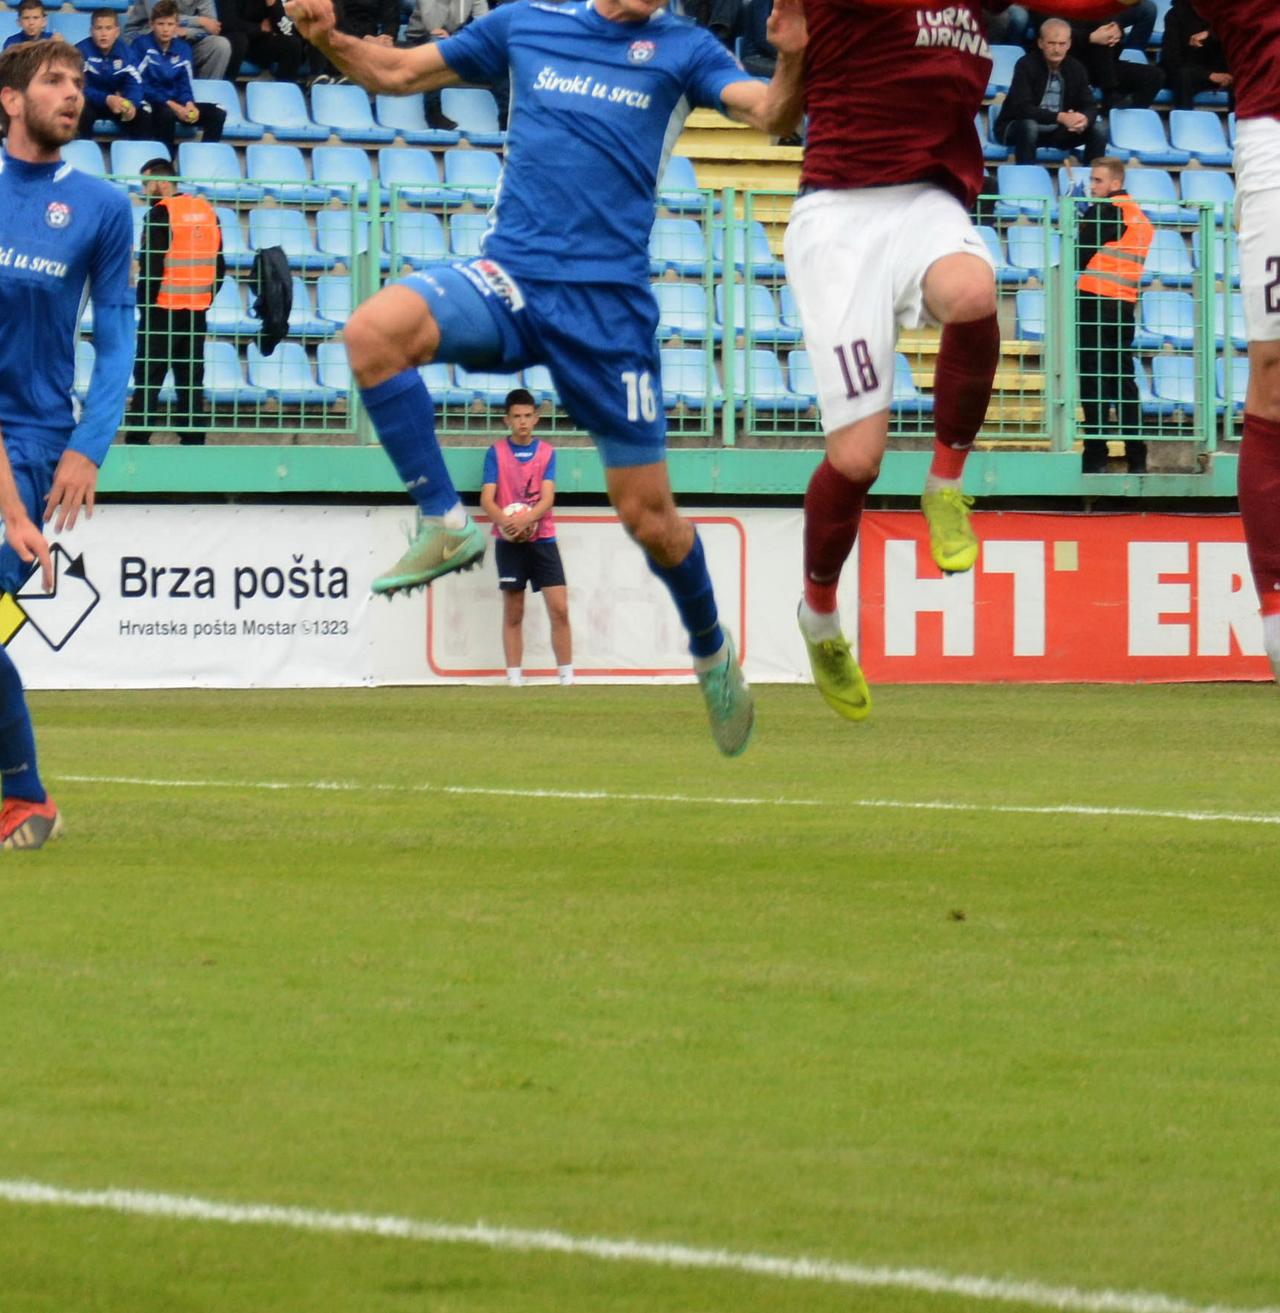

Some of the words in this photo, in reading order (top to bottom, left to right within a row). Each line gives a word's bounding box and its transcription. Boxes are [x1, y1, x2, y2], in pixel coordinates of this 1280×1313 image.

[533, 66, 589, 97] Široki
[592, 82, 607, 99] u
[607, 86, 651, 109] srcu
[13, 254, 28, 269] u
[28, 258, 69, 279] srcu
[832, 338, 879, 400] 18
[621, 370, 658, 423] 16
[120, 556, 216, 599] Brza
[234, 553, 348, 610] pošta
[883, 539, 1045, 657] HT
[120, 619, 188, 636] Hrvatska
[193, 618, 237, 638] pošta
[242, 619, 296, 636] Mostar
[313, 619, 349, 636] 1323
